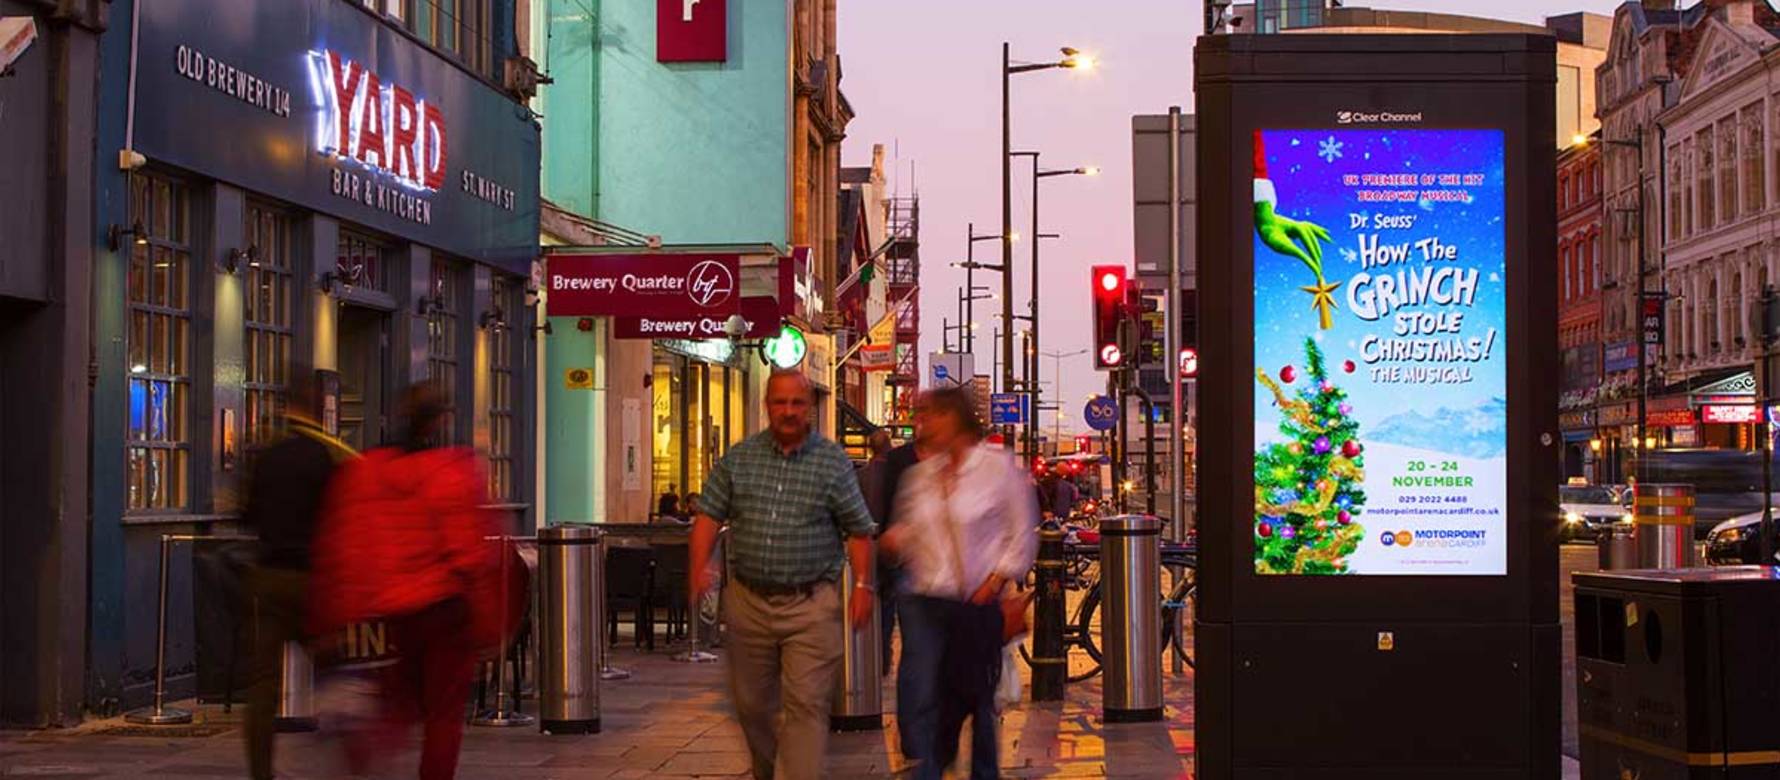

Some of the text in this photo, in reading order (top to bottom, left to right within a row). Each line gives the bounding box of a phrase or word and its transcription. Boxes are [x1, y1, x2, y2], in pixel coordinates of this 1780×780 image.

[178, 45, 204, 81] OLD
[207, 57, 273, 111] BREWERY
[308, 49, 449, 191] YARD
[1353, 112, 1422, 122] Clear Channel
[1343, 174, 1485, 186] UK PREMIERE OF THE HIT
[333, 168, 431, 225] BAR & KITCHEN
[462, 170, 477, 196] ST.
[504, 189, 515, 212] ST
[1357, 190, 1470, 201] BROADWAY MUSICAL
[1350, 213, 1370, 229] Dr.
[1358, 233, 1457, 269] How The
[553, 274, 684, 293] Brewery Quarter
[1346, 266, 1480, 321] GRINCH
[640, 319, 696, 335] Brewery
[1394, 311, 1463, 336] STOLE
[1359, 327, 1497, 364] CHRISTMAS!
[1370, 366, 1473, 384] THE MUSICAL
[1408, 461, 1425, 471] 20
[1441, 461, 1458, 471] 24
[1392, 476, 1474, 487] NOVEMBER
[1367, 508, 1499, 516] motorpointarenacardiff.co.uk
[1415, 530, 1486, 538] MOTORPOINT
